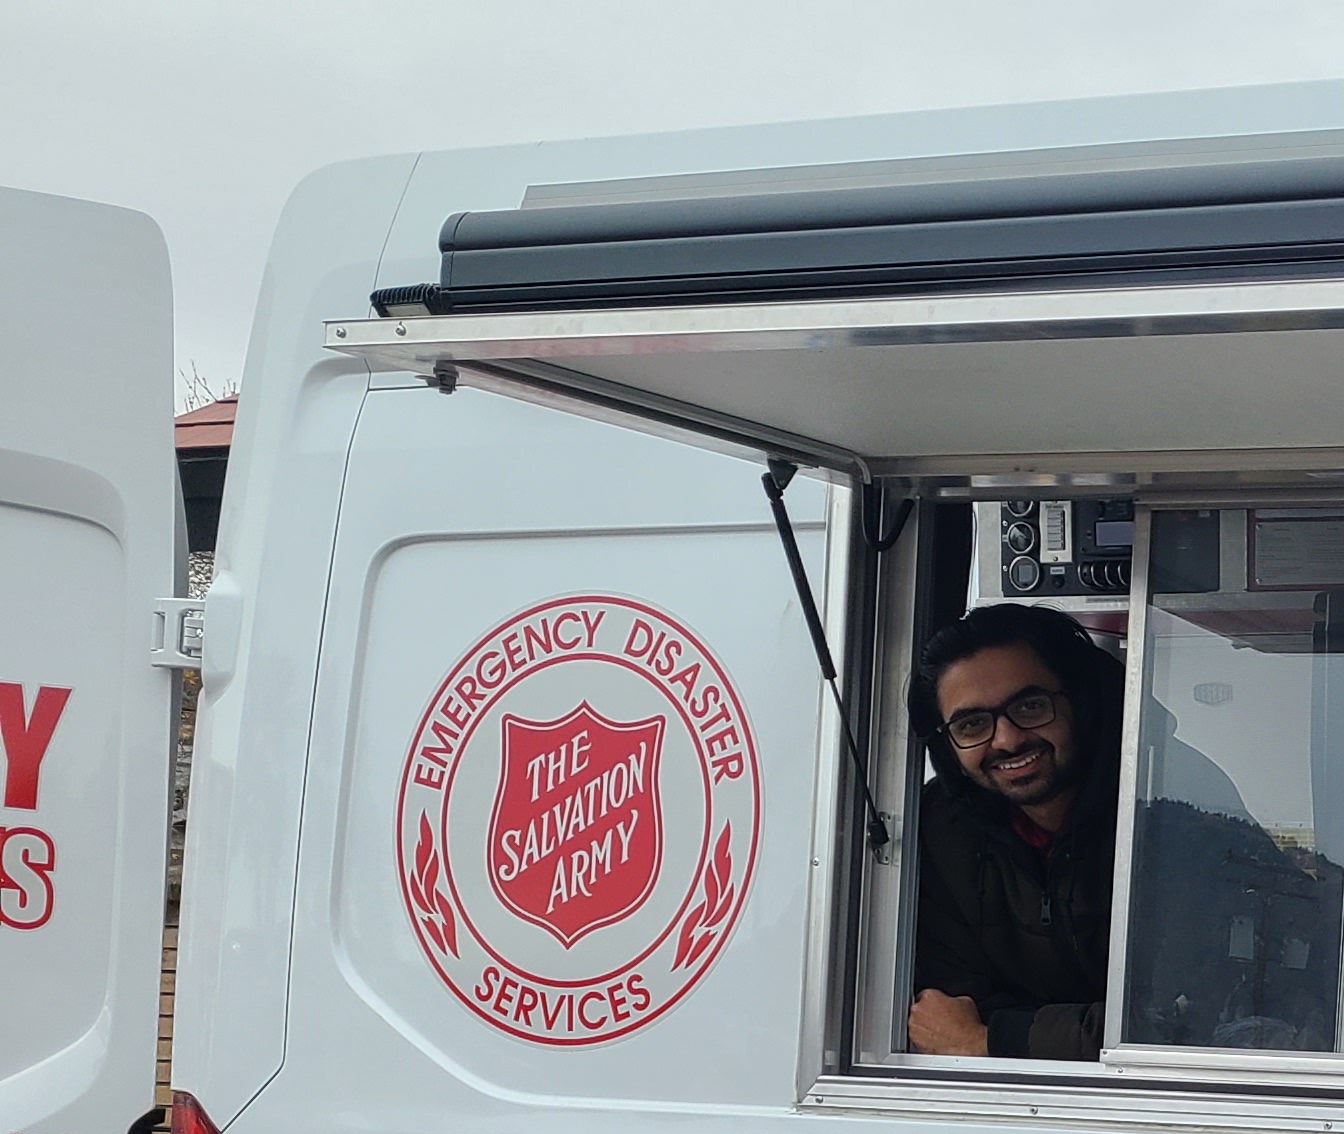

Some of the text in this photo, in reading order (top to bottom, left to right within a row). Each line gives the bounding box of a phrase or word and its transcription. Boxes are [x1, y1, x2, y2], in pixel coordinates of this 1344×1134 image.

[413, 609, 746, 792] EMERGENCY DISASTER
[499, 741, 648, 882] SALVATION
[525, 729, 593, 802] THE
[545, 809, 640, 916] ARMY
[473, 964, 652, 1033] SERVICES
